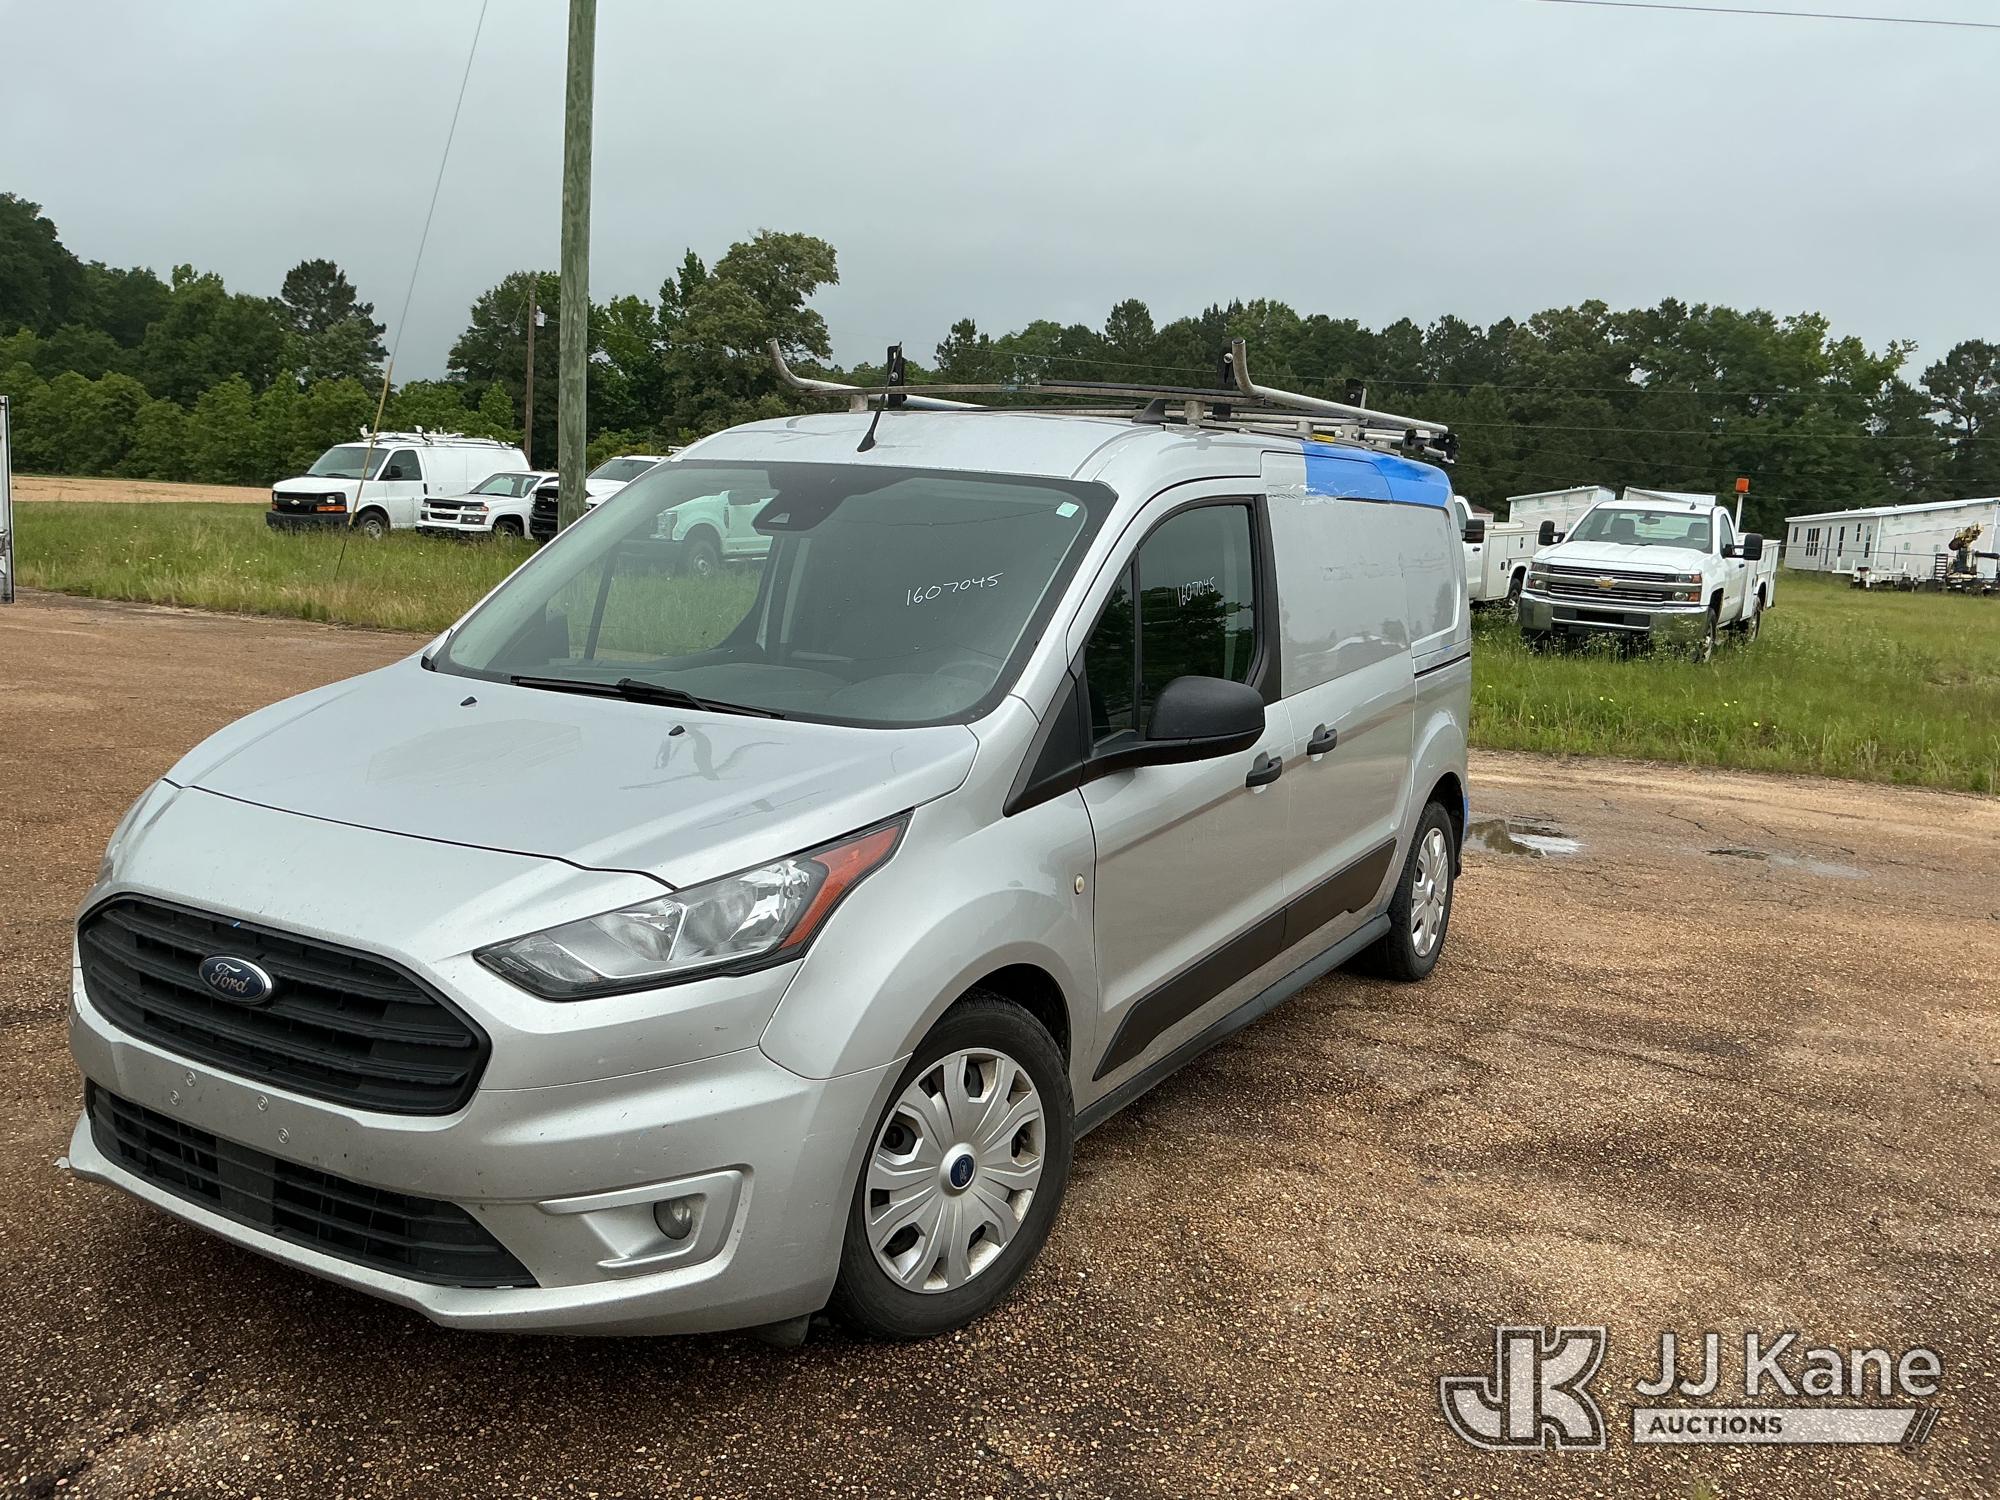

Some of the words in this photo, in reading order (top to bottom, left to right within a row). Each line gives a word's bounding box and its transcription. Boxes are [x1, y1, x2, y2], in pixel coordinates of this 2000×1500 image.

[905, 572, 1004, 606] 1607045
[1176, 576, 1216, 608] 1607045
[210, 962, 251, 994] Ford
